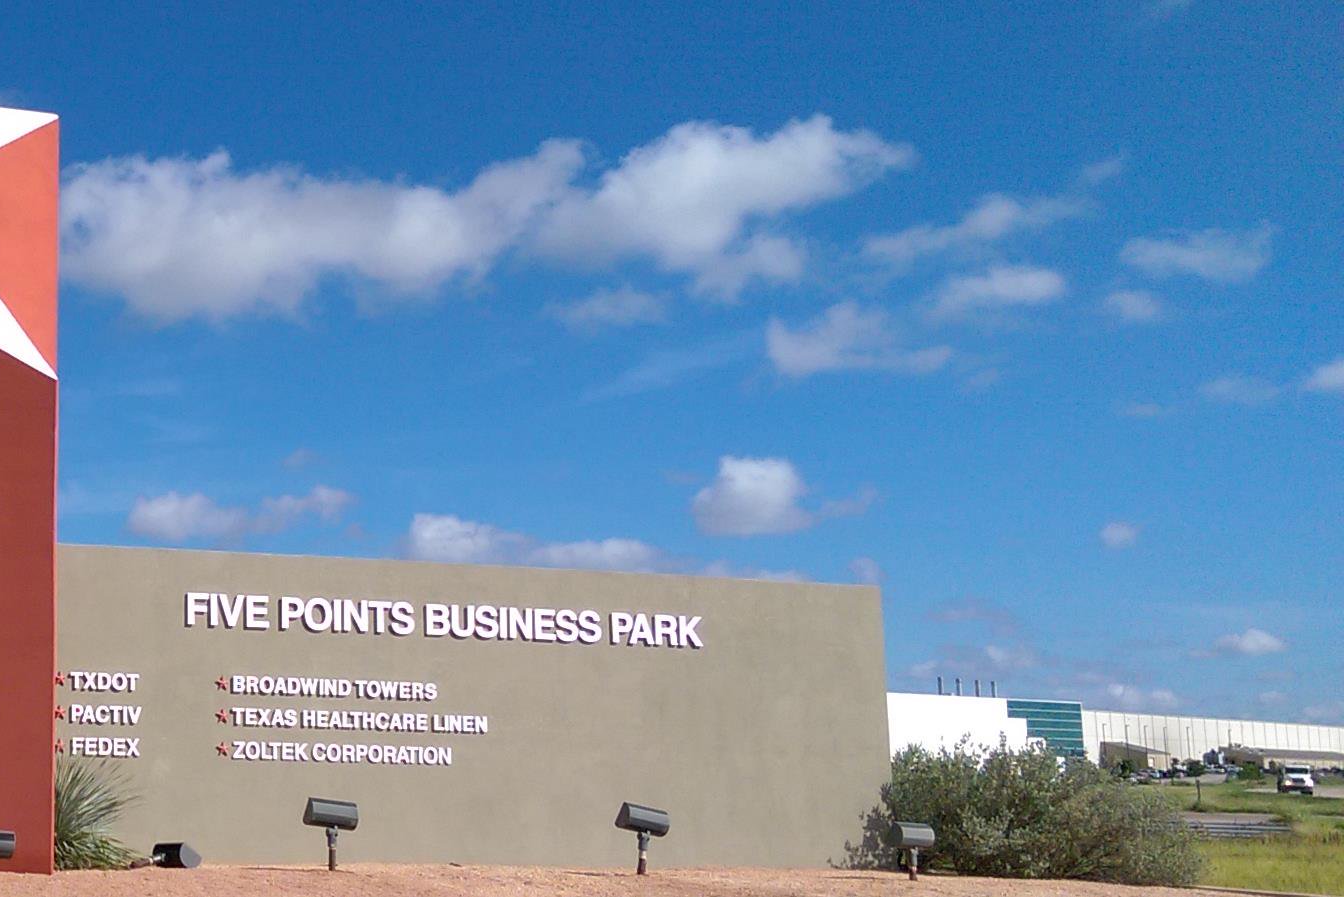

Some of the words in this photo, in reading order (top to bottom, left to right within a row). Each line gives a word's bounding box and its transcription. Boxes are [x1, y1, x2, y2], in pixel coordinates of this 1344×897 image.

[184, 592, 269, 630] FIVE
[281, 597, 415, 635] POINTS
[423, 603, 602, 644] BUSINESS
[609, 611, 703, 648] PARK
[70, 671, 139, 693] TXDOT
[232, 675, 352, 698] BROADWIND
[355, 680, 438, 701] TOWERS
[71, 704, 142, 726] PACTIV
[232, 708, 298, 730] TEXAS
[302, 710, 429, 733] HEALTHCARE
[433, 714, 488, 734] LINEN
[71, 737, 140, 758] FEDEX
[232, 741, 309, 762] ZOLTEK
[312, 743, 453, 766] CORPORATION
